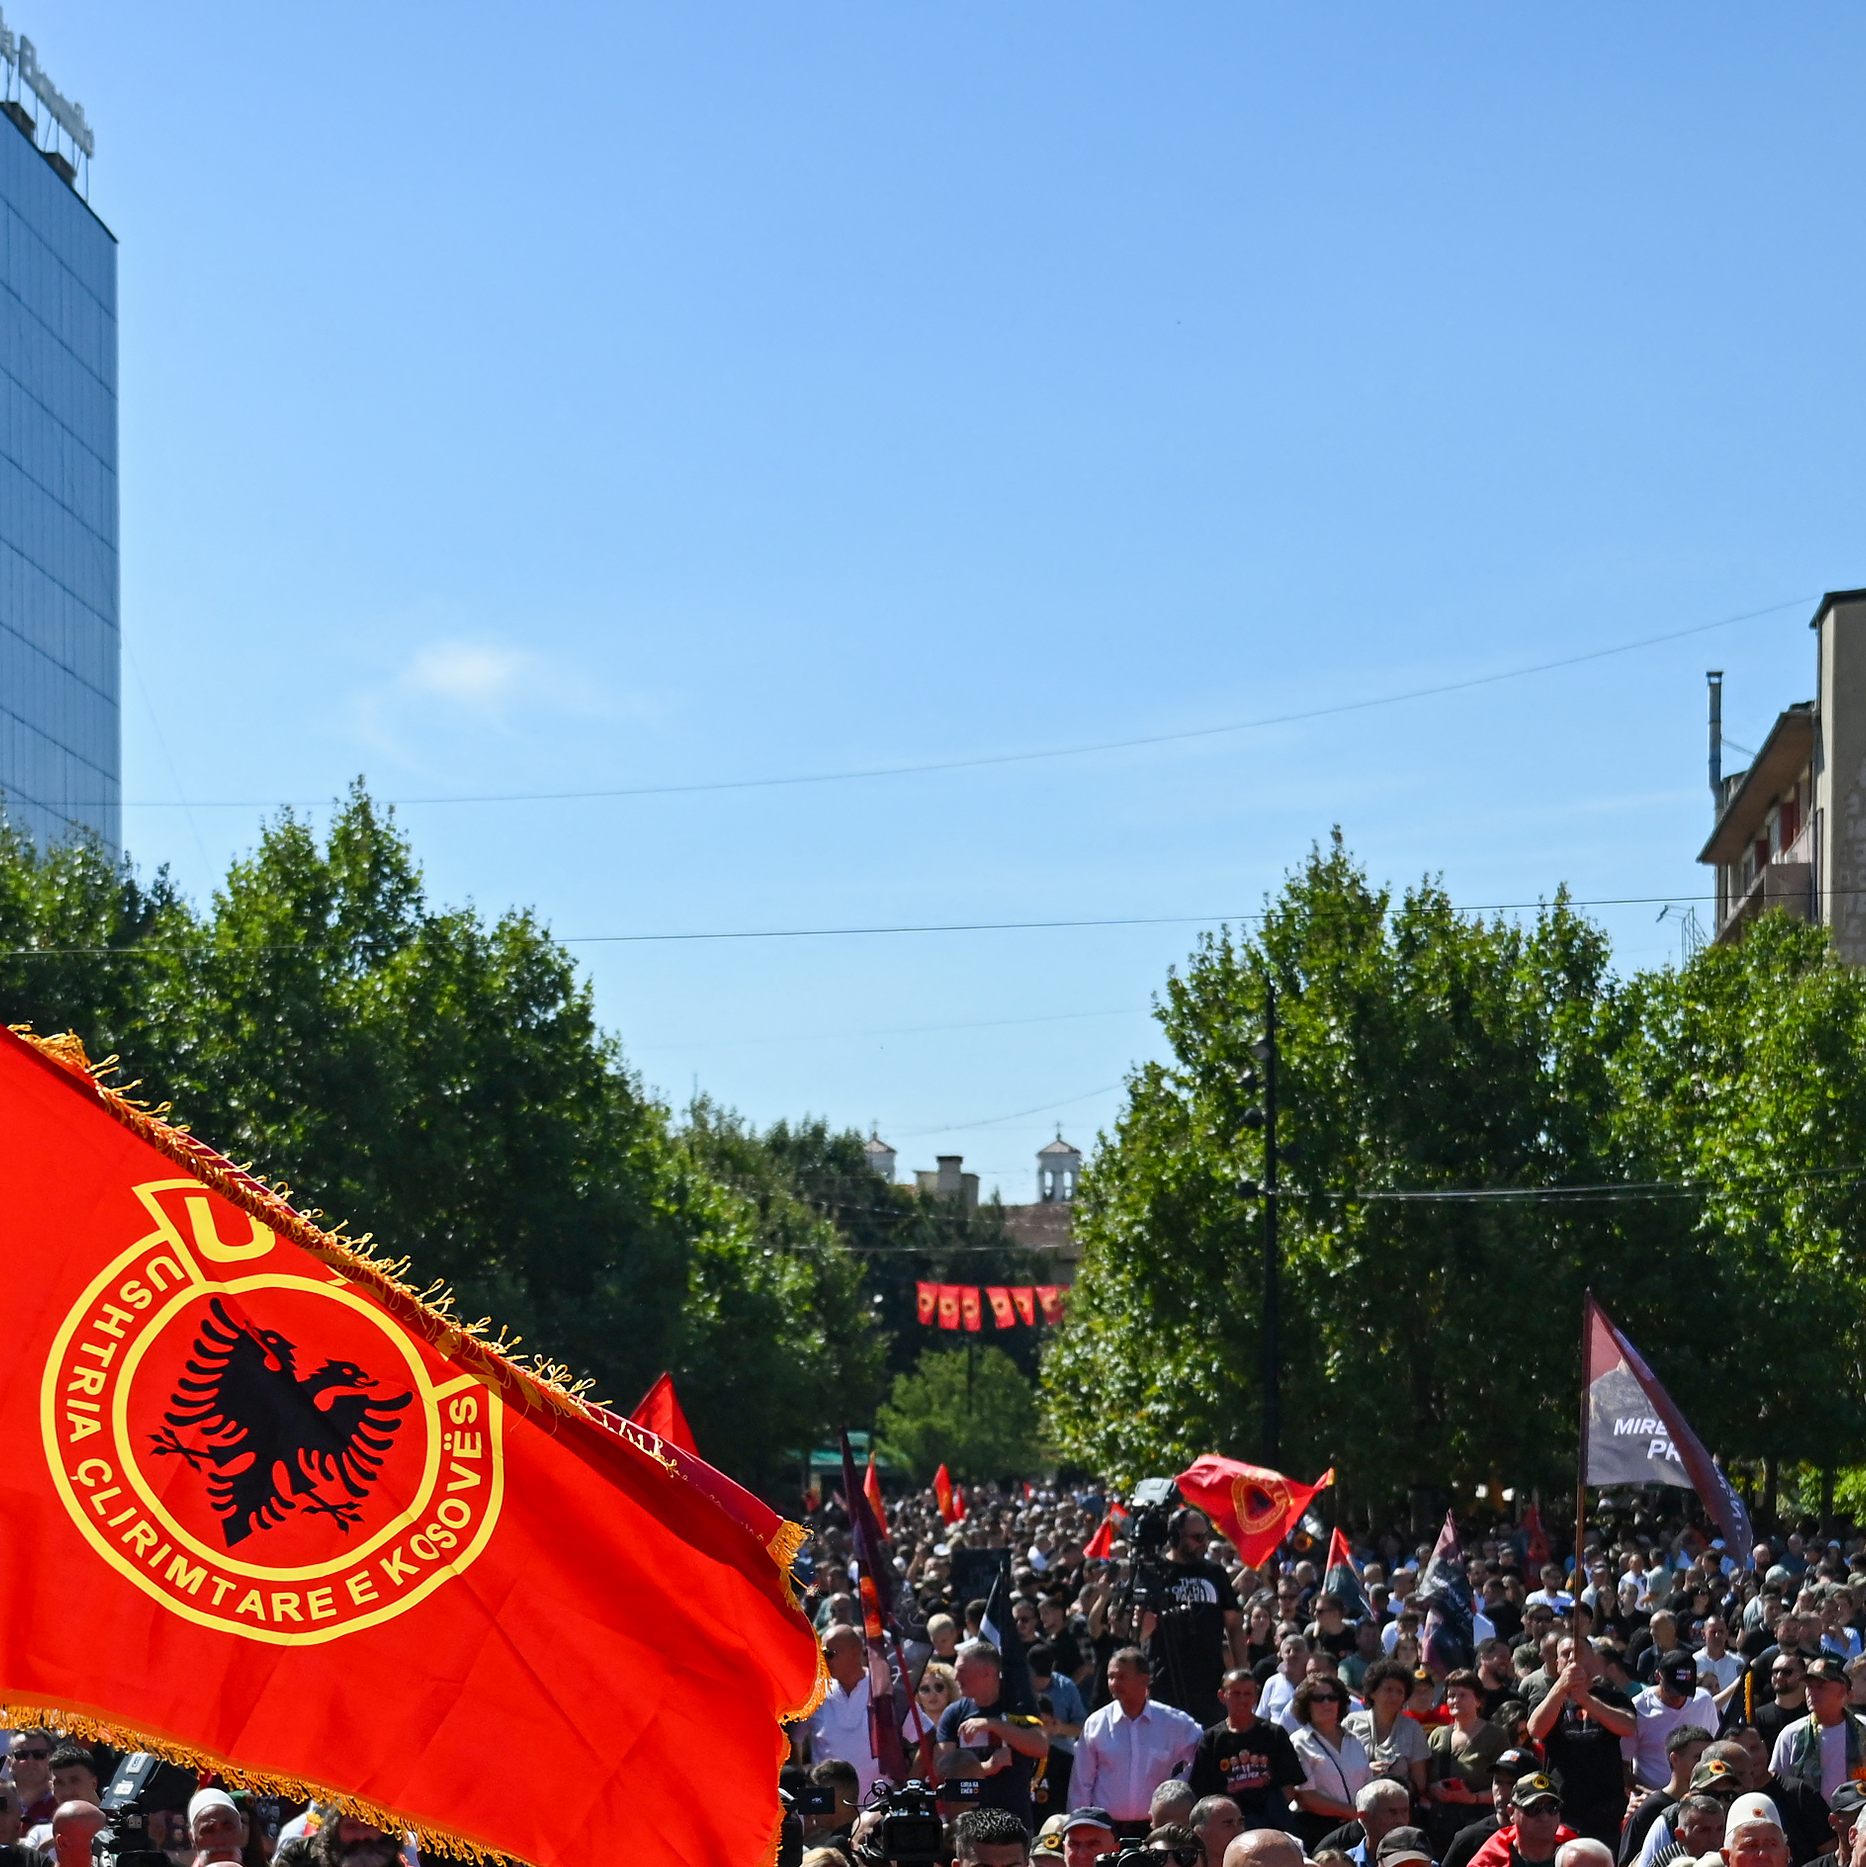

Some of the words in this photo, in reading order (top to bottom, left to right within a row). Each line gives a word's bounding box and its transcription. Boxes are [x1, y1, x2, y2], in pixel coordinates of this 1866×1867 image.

[66, 1255, 186, 1443] USHTRIA
[71, 1457, 338, 1623] ÇLIRIMTARE
[378, 1394, 483, 1587] KOSOVËS
